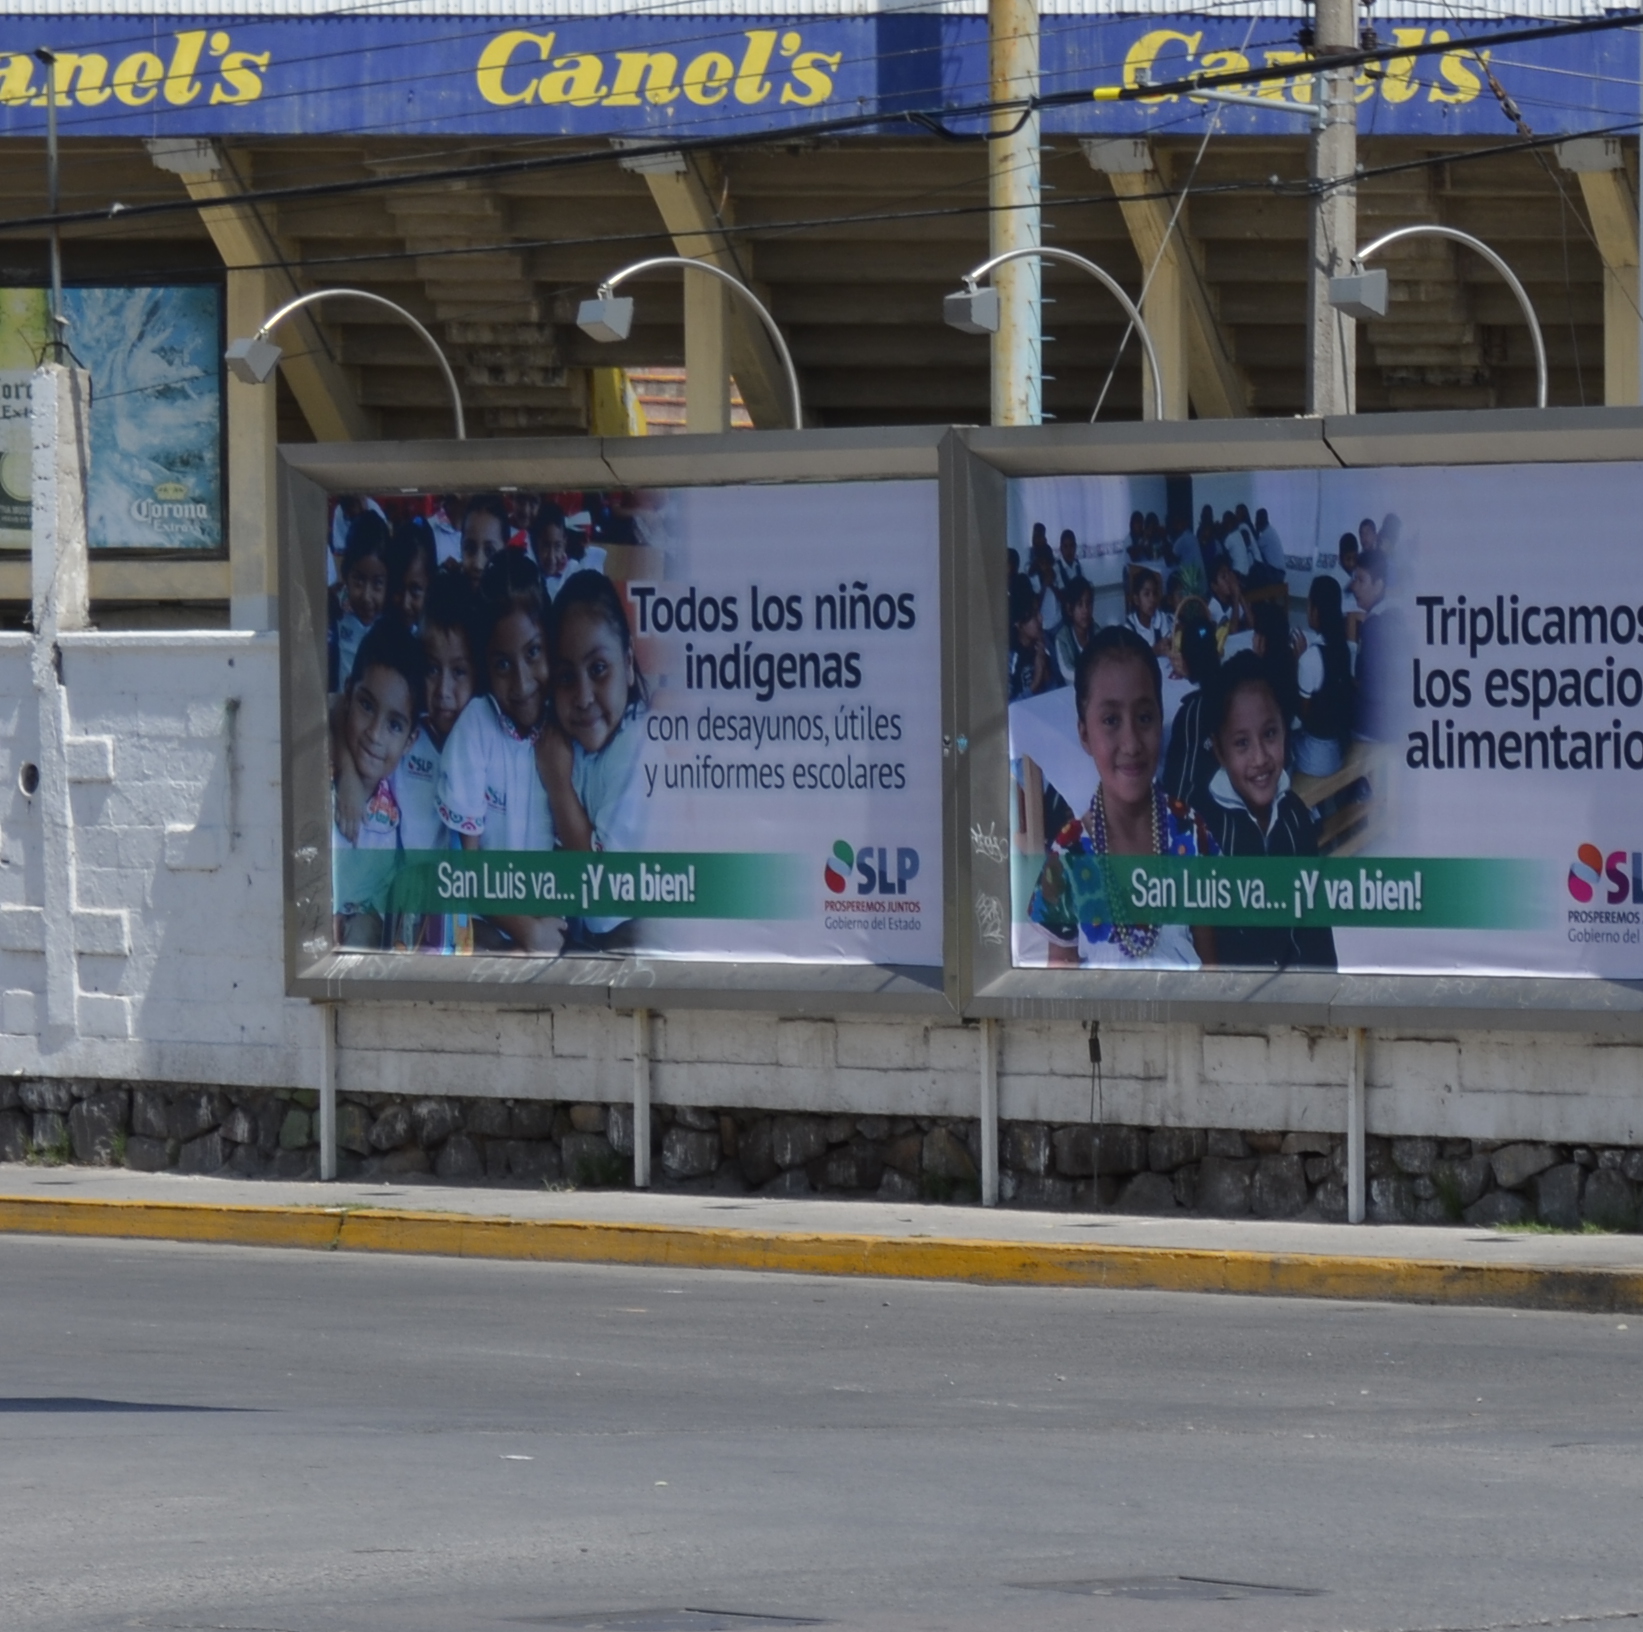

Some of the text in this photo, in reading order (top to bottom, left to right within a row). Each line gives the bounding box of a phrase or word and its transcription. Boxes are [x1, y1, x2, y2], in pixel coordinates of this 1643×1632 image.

[0, 29, 271, 106] anel's
[477, 29, 843, 107] Canel's
[130, 497, 209, 523] Corona
[630, 580, 917, 633] Todos los niños
[685, 640, 862, 702] indígenas
[1412, 657, 1472, 708] los
[646, 704, 902, 750] con desayunos, útiles
[644, 754, 906, 798] y uniformes escolares
[437, 861, 696, 909] San Luis va... ¡Y va bien!
[856, 846, 920, 895] SLP
[1131, 868, 1422, 919] San Luis va... ¡Y va bien!
[824, 900, 921, 913] PROSPEREMOS JUNTOS
[824, 916, 921, 931] Gobierno del Estado
[1567, 910, 1640, 924] PROSPEREMOS
[1567, 927, 1620, 943] Gobierno
[1622, 928, 1640, 944] del
